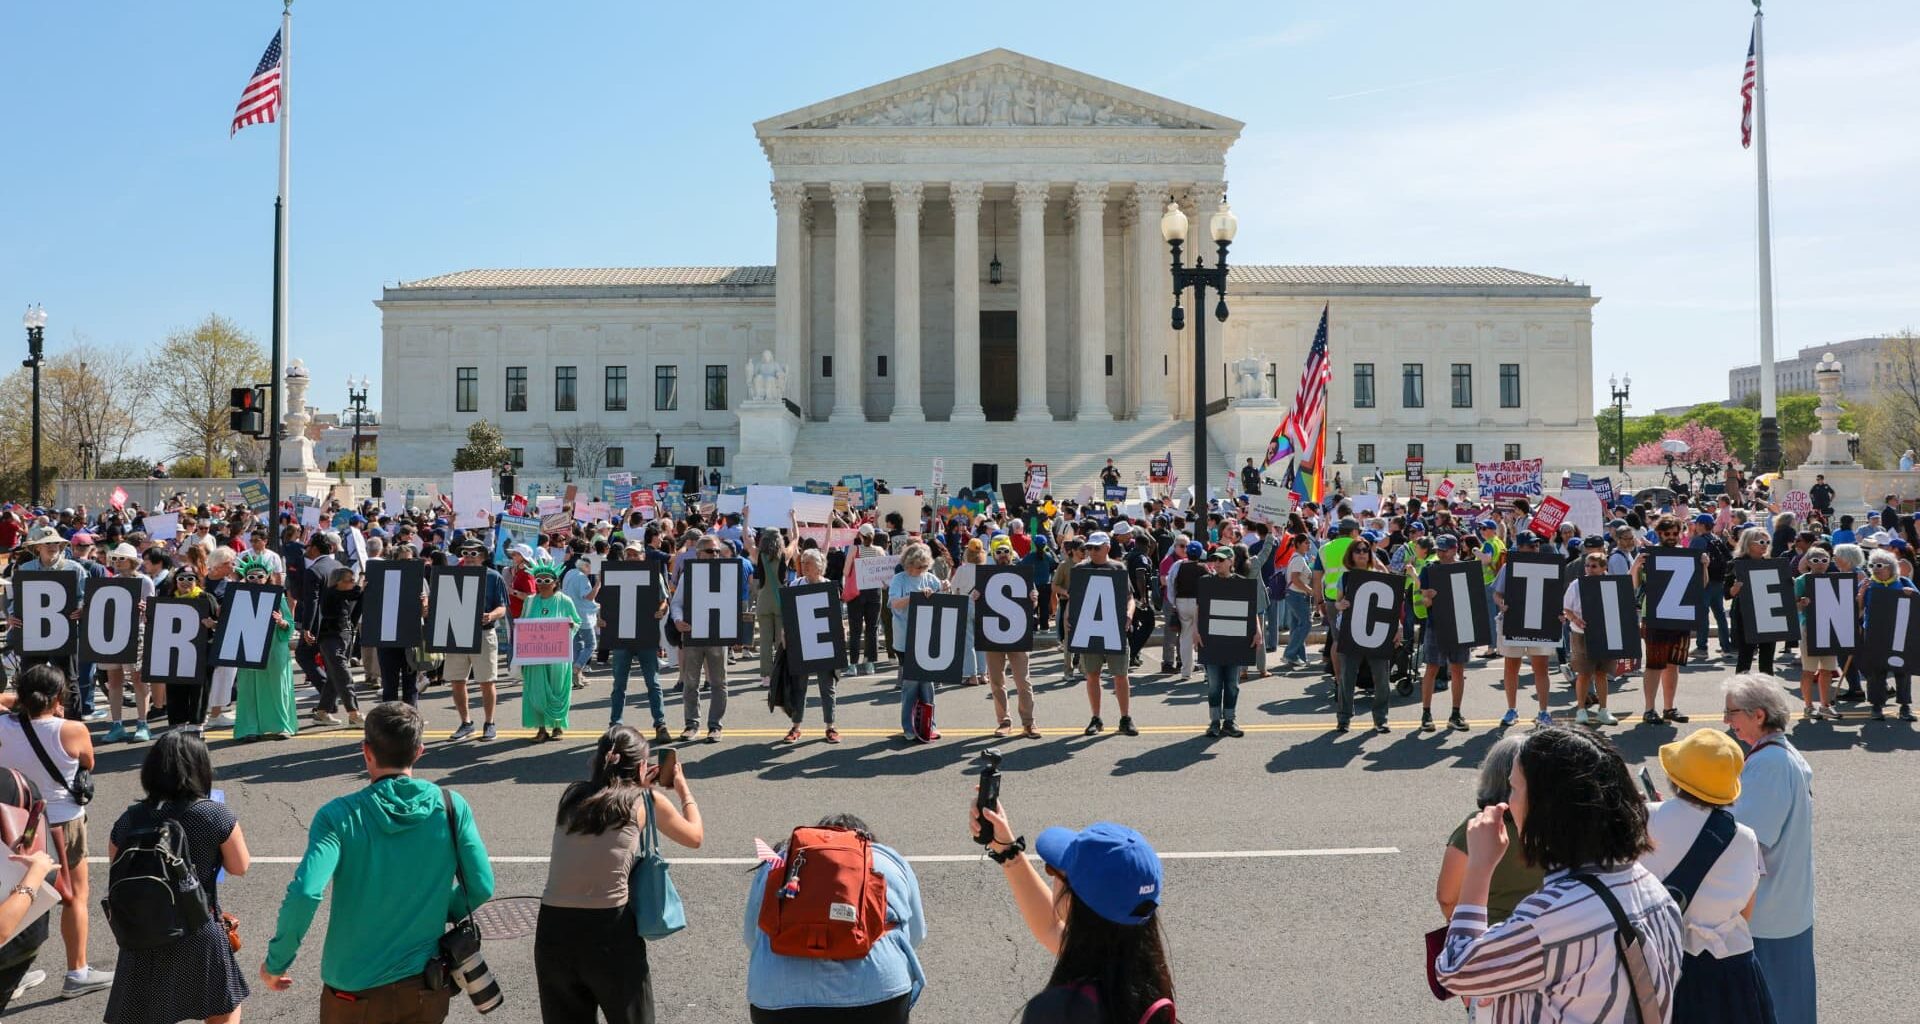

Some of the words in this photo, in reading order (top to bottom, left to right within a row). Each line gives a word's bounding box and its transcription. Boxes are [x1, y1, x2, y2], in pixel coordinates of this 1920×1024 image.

[1478, 481, 1541, 497] IMMIGRANTS
[1786, 491, 1807, 502] STOP
[1541, 503, 1564, 519] BIRTH
[1782, 502, 1811, 511] RACISM
[1536, 511, 1560, 527] RIGHT
[516, 641, 564, 655] BIRTHRIGHT
[1139, 884, 1155, 895] ACLU
